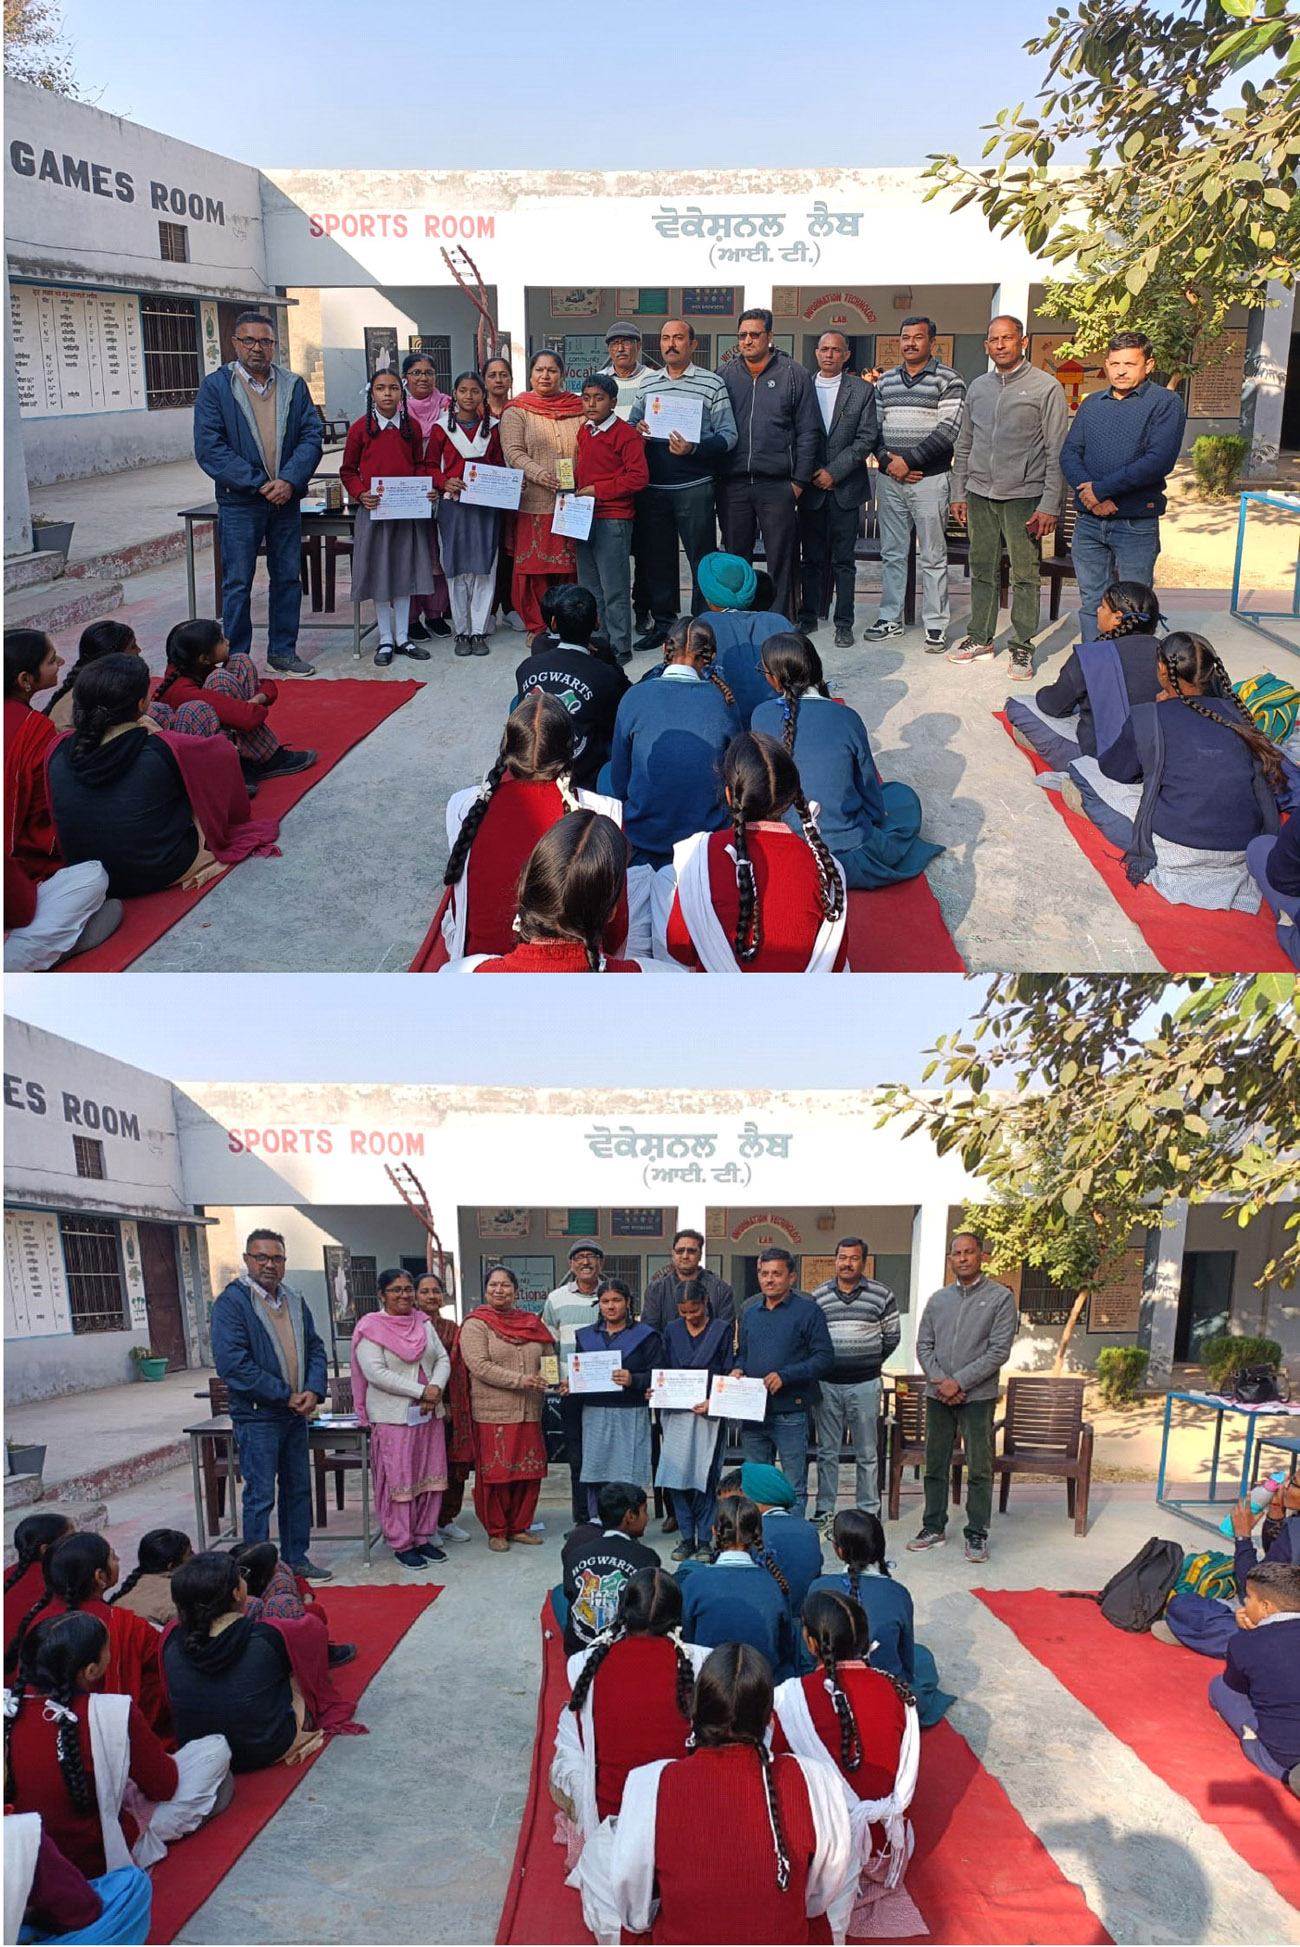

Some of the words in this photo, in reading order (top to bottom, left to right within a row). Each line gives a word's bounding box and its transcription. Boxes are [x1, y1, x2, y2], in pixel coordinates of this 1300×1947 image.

[10, 139, 135, 204] GAMES
[150, 180, 226, 226] ROOM
[309, 213, 408, 238] SPORTS
[424, 214, 495, 239] ROOM
[651, 204, 787, 242] ਵੋਕੇਸ਼ਨਲ
[806, 200, 865, 237] ਲੈਬ
[803, 292, 842, 320] INFORMATION
[844, 293, 878, 324] TECHNOLOGY
[831, 315, 847, 324] LAB
[522, 671, 594, 701] HOGWARTS
[62, 1091, 141, 1141] ROOM
[228, 1128, 333, 1154] SPORTS
[350, 1130, 425, 1156] ROOM
[585, 1124, 718, 1162] ਵੋਕੇਸ਼ਨਲ
[737, 1121, 794, 1159] ਲੈਬ
